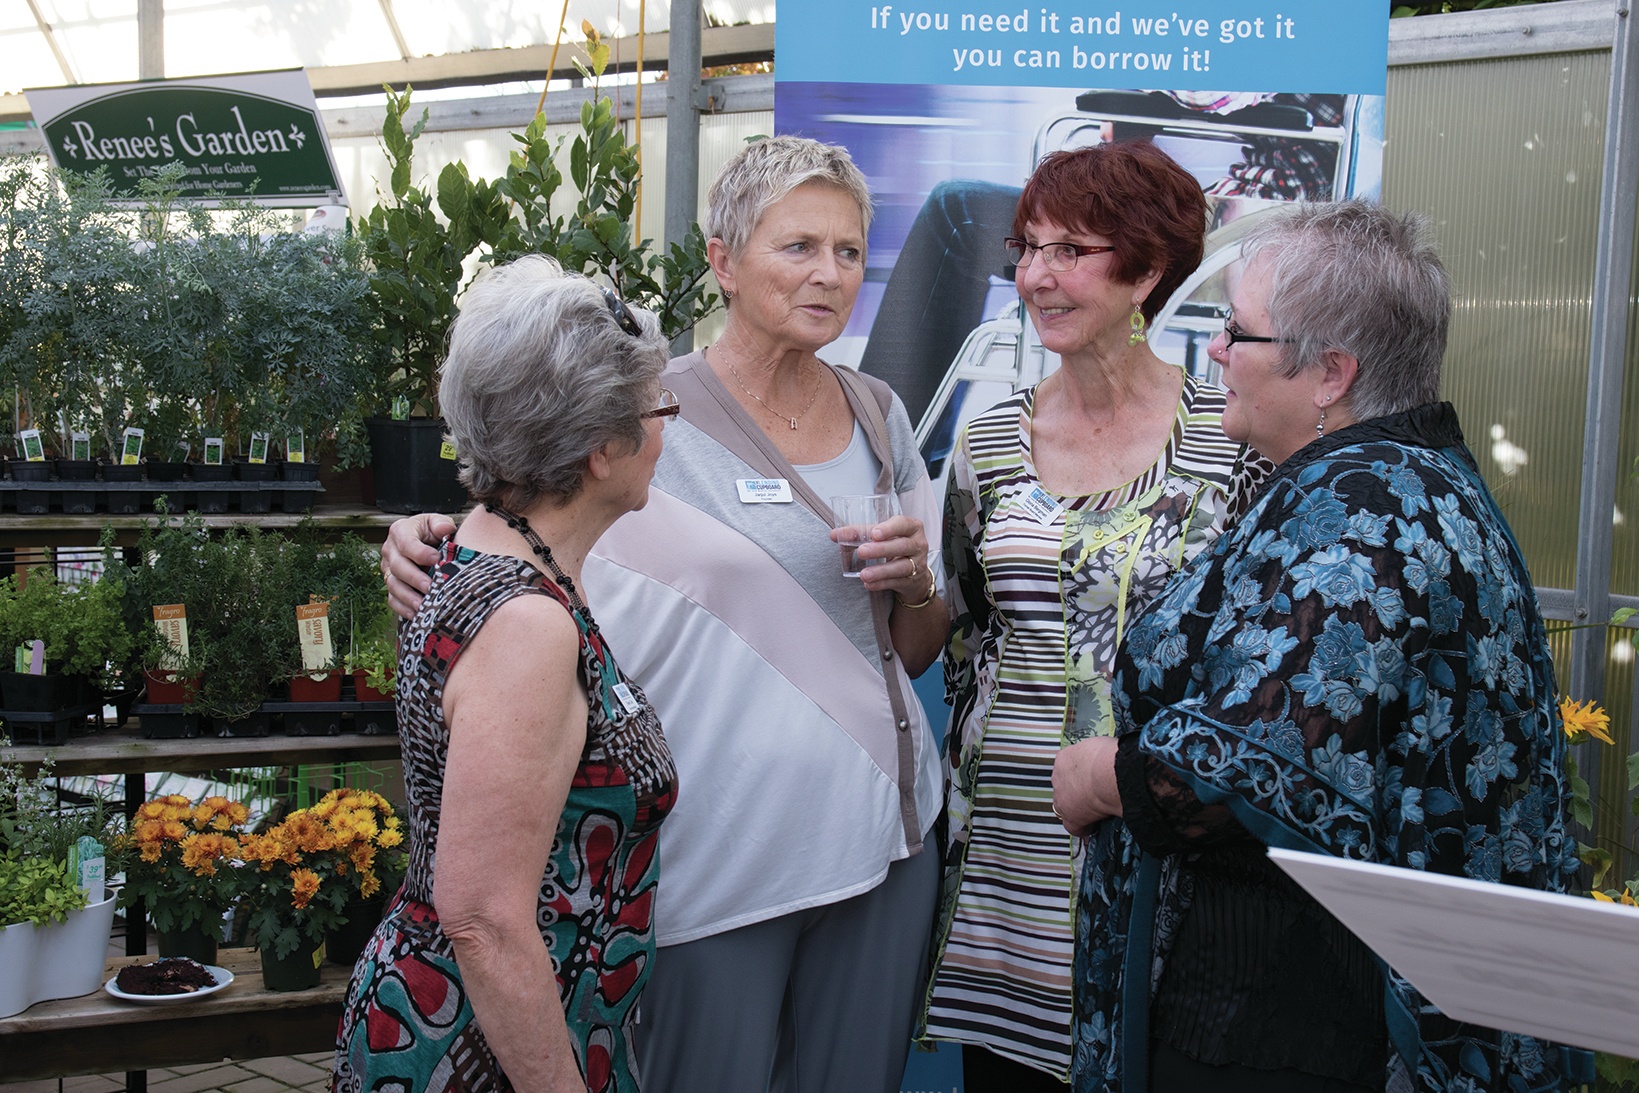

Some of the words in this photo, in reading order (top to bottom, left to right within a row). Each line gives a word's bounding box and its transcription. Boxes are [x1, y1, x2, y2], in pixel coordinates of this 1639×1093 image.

[871, 6, 893, 29] If
[900, 12, 949, 36] you
[961, 8, 1029, 33] need
[1041, 8, 1060, 34] it
[1069, 12, 1121, 36] and
[1219, 17, 1265, 44] got
[1276, 14, 1296, 39] it
[953, 46, 1002, 72] you
[1013, 48, 1061, 68] can
[1072, 45, 1172, 72] borrow
[1183, 46, 1210, 72] it!
[71, 116, 175, 161] Renee's
[175, 105, 290, 157] Garden
[201, 163, 224, 175] Your
[224, 161, 257, 174] Garden
[312, 619, 324, 645] savory
